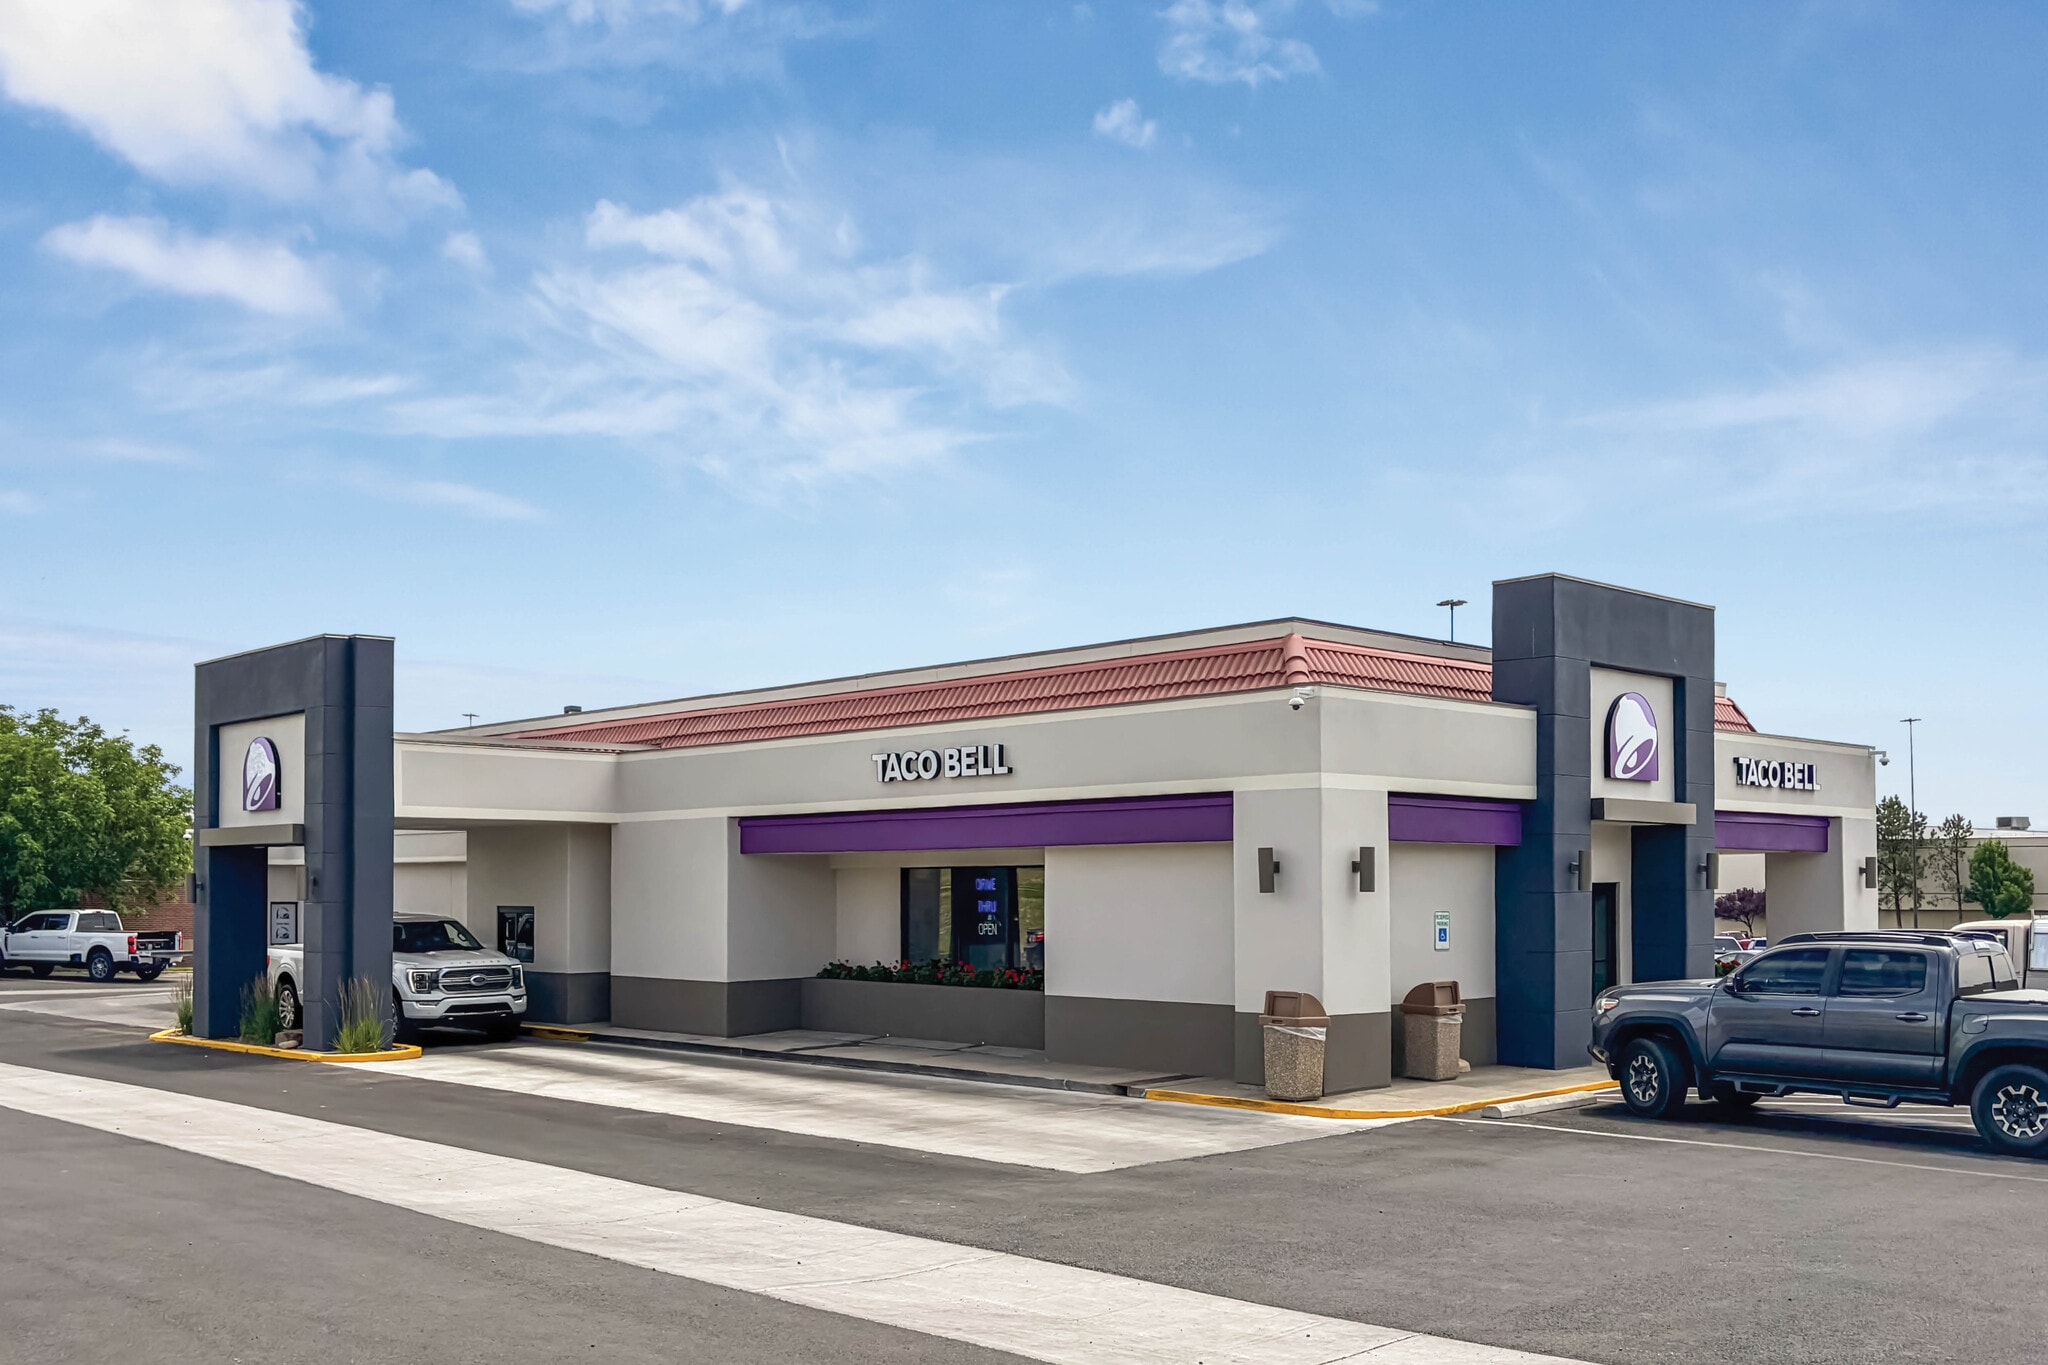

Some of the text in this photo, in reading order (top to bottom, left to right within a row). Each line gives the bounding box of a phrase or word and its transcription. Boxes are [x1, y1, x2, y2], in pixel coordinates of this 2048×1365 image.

[871, 744, 1011, 782] TACO BELL
[1736, 756, 1821, 791] TACO BELL
[978, 923, 998, 935] OPEN
